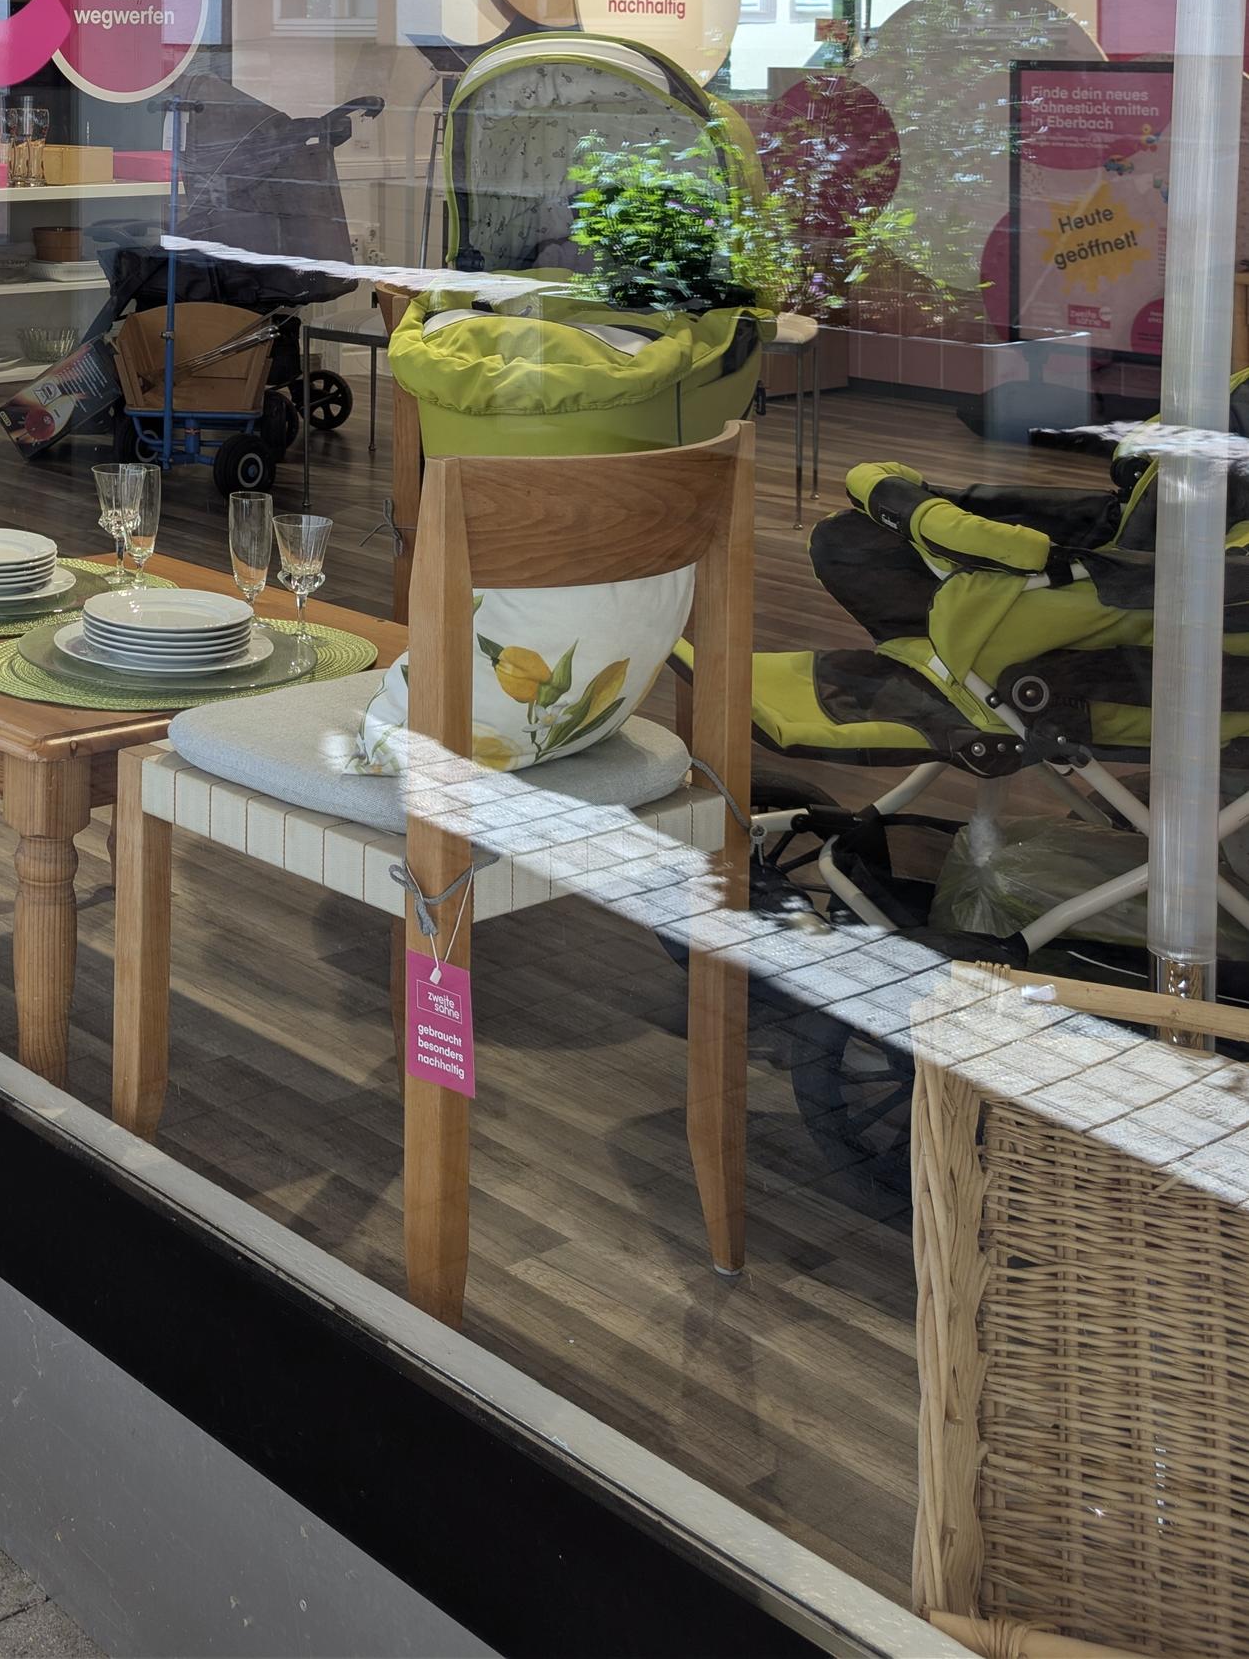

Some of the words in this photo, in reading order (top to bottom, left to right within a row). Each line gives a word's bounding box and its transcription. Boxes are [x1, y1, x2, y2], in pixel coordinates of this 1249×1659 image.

[73, 5, 175, 30] wegwerfen
[1031, 86, 1068, 99] Finde
[1072, 87, 1102, 100] dein
[1105, 90, 1149, 101] neues
[1031, 100, 1111, 116] Sahnestück
[1114, 104, 1159, 116] mitten
[1031, 115, 1043, 127] in
[1047, 116, 1114, 130] Eberbach
[1058, 208, 1114, 234] Heute
[1054, 230, 1139, 270] geöffnet!
[427, 991, 455, 1009] zweite
[434, 1003, 460, 1020] sahne
[417, 1023, 462, 1047] gebraucht
[417, 1036, 464, 1063] besonders
[417, 1053, 465, 1080] nachhaltig
